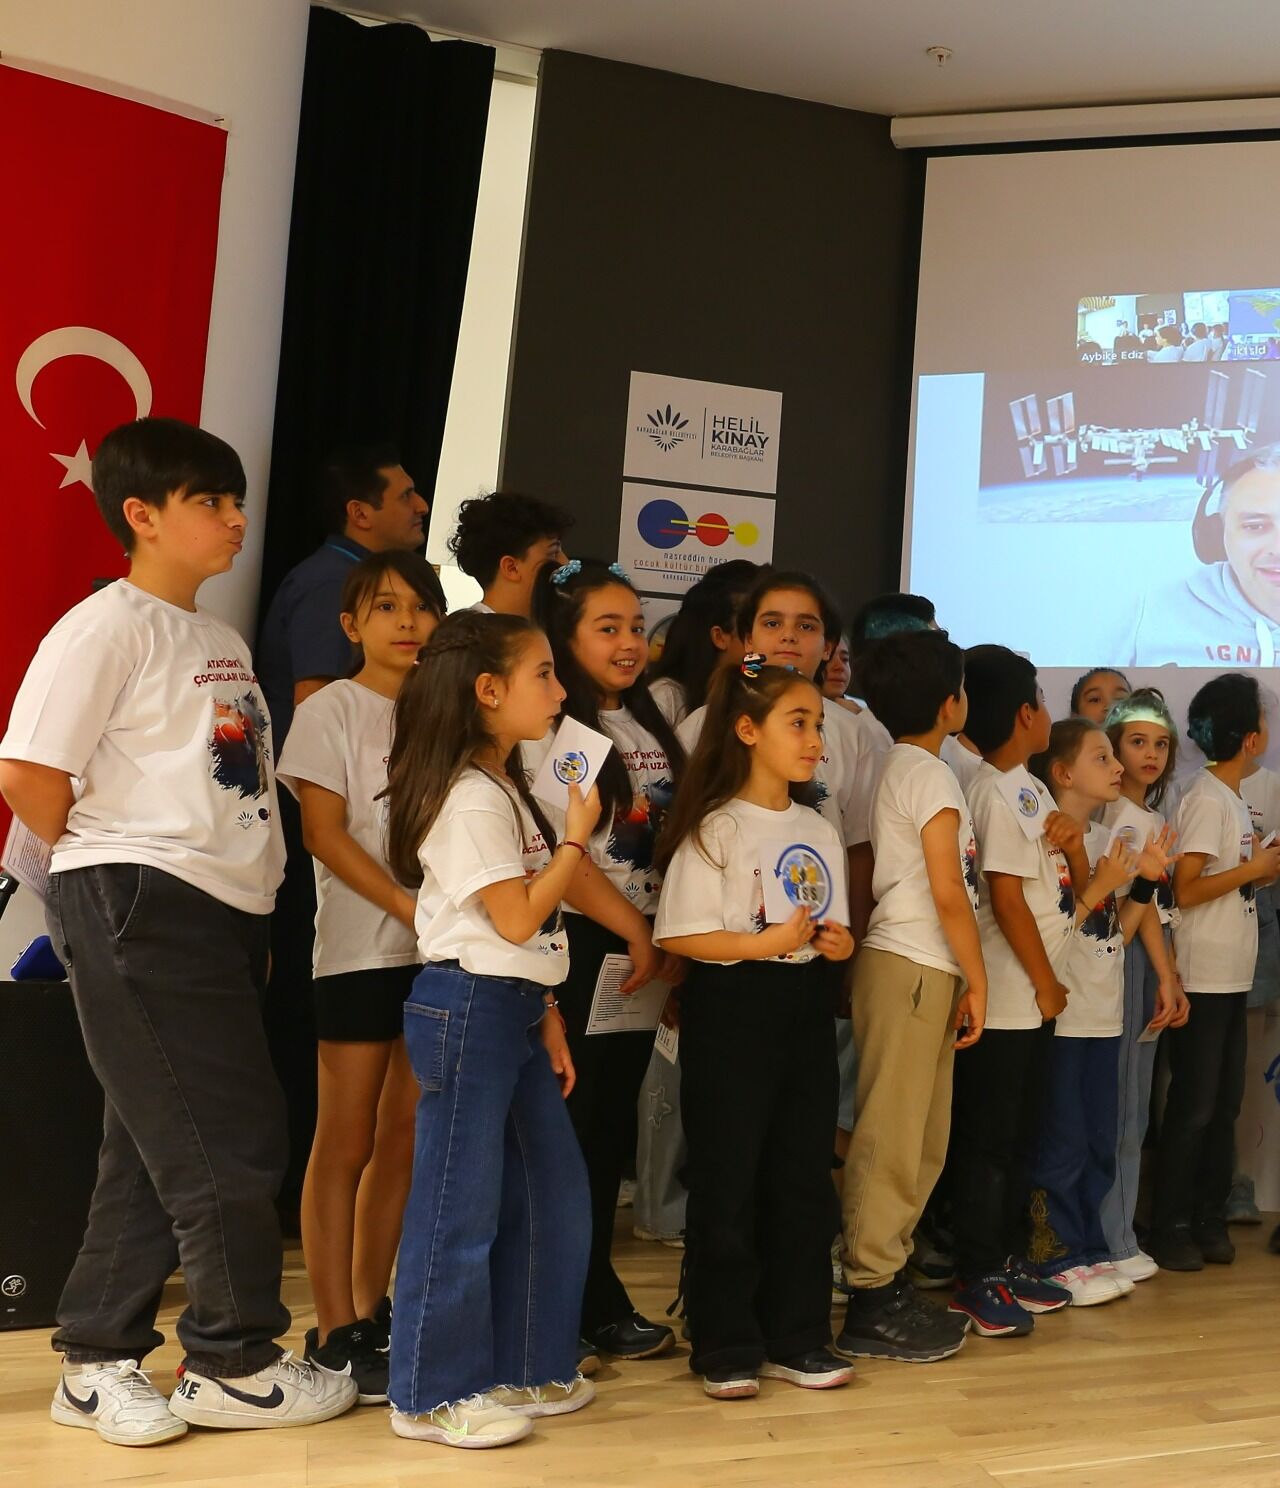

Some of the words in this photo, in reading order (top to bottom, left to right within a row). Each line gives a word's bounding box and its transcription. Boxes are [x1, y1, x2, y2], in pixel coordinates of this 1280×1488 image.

[1081, 352, 1117, 363] Aybike
[712, 415, 765, 435] HELİL
[711, 429, 770, 449] KINAY
[711, 444, 765, 456] KARABAĞLAR
[663, 552, 705, 563] nasreddin
[633, 559, 660, 569] çocuk
